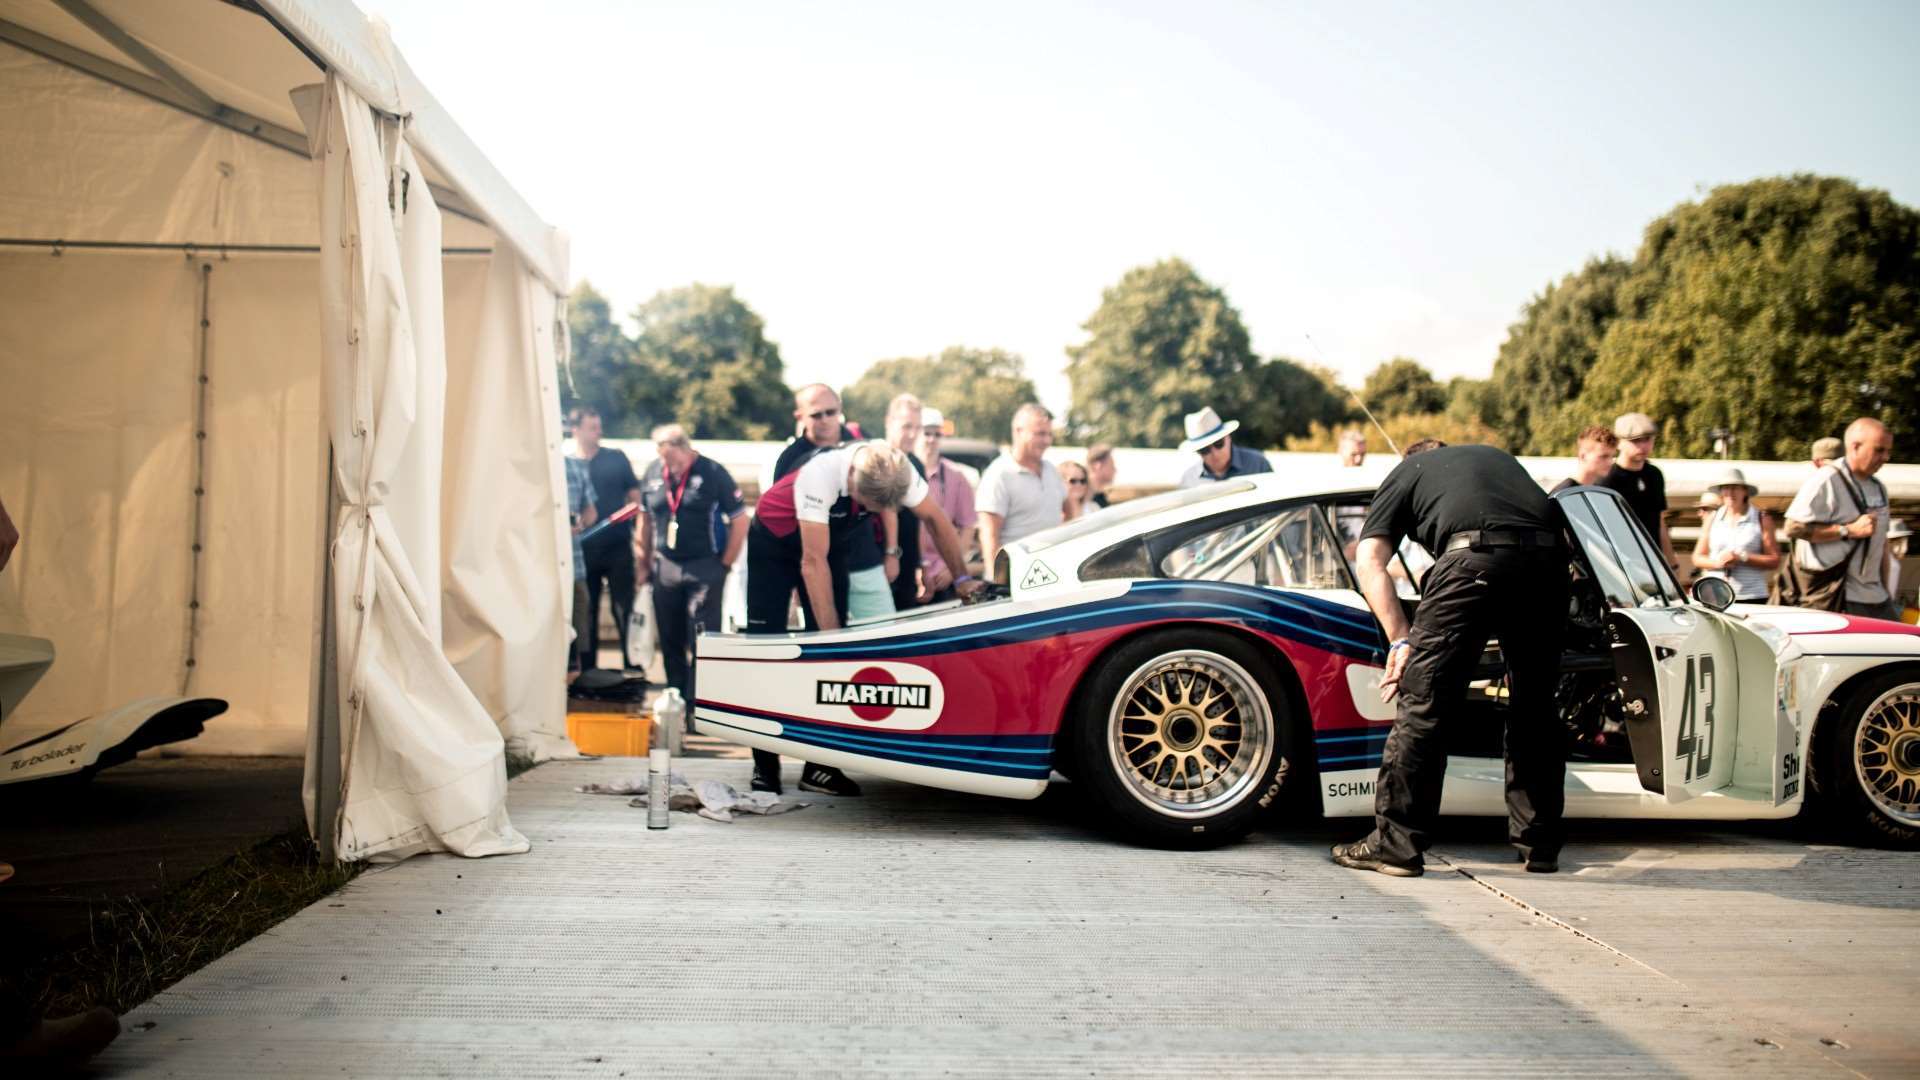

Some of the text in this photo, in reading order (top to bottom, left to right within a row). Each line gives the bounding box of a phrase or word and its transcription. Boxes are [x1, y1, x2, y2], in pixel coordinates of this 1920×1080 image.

[821, 682, 927, 707] MARTINI
[1675, 653, 1715, 784] 43
[1258, 756, 1290, 808] AVON
[1328, 781, 1379, 797] SCHMI
